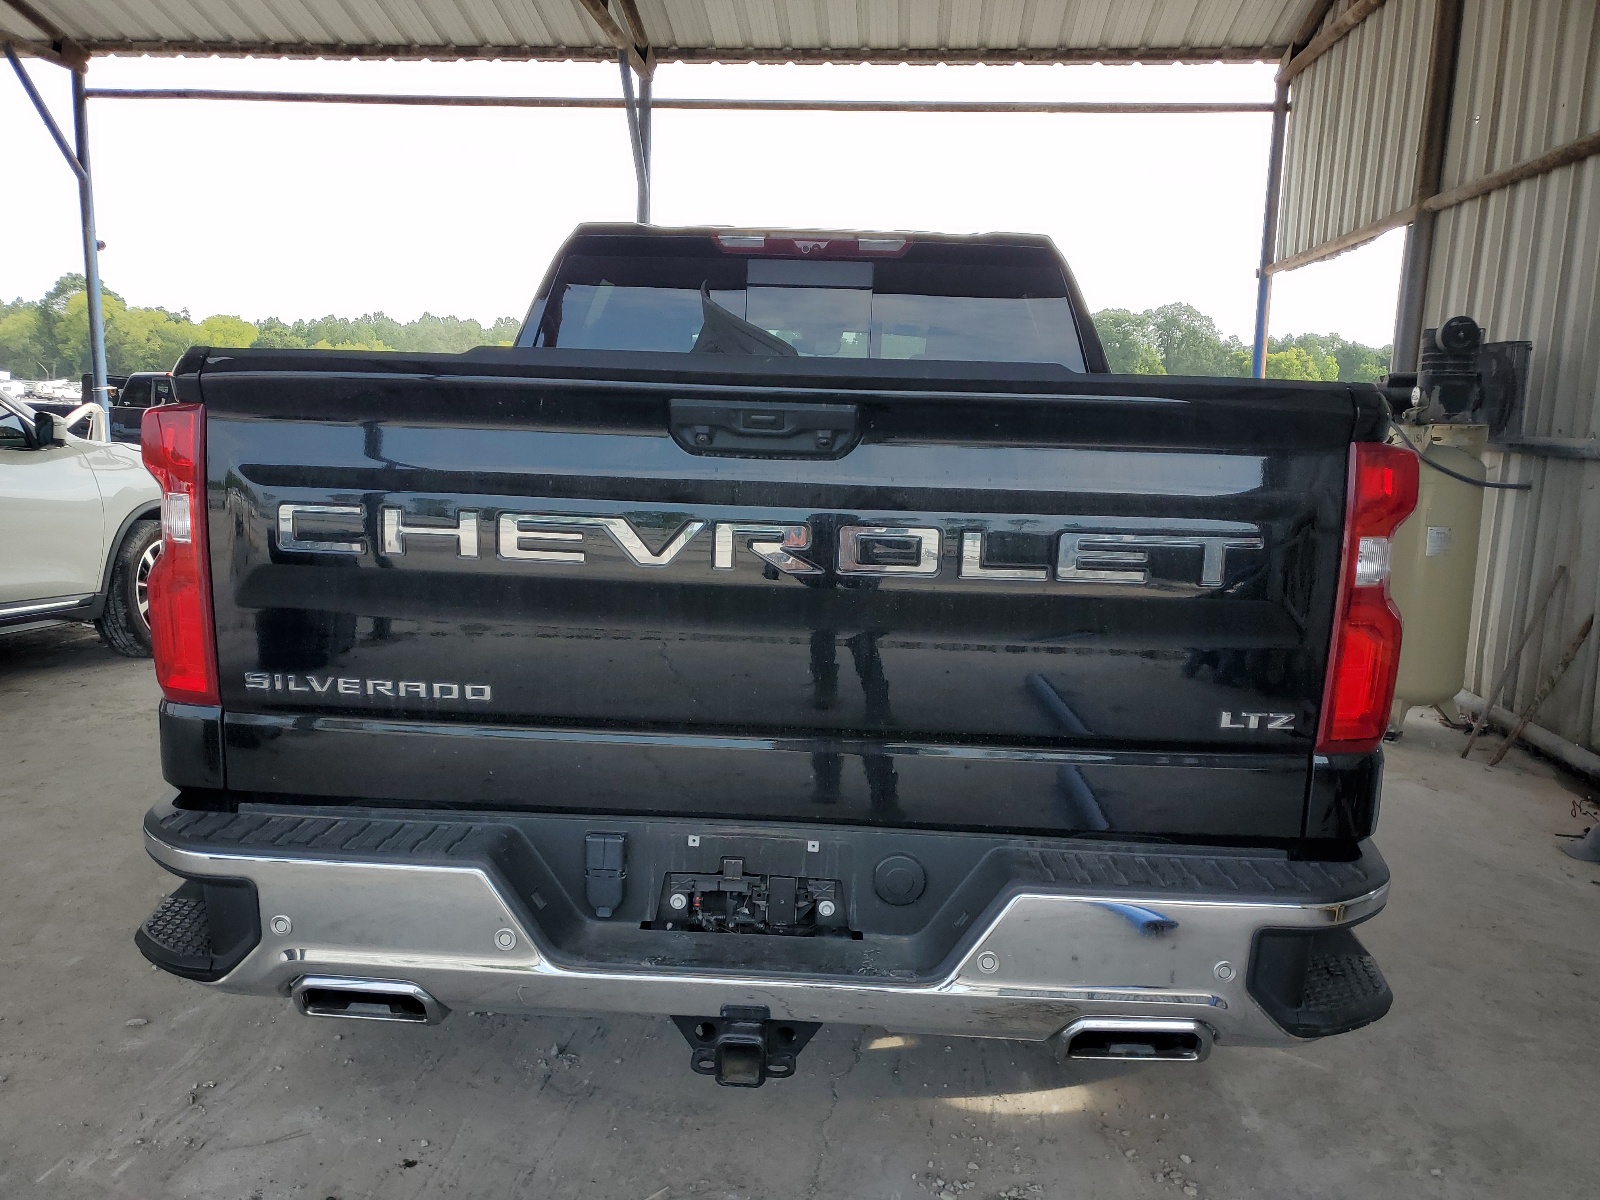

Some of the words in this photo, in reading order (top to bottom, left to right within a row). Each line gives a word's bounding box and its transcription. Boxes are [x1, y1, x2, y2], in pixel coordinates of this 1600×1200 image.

[278, 502, 1264, 587] CHEVROLET
[244, 672, 492, 701] SILVERADO
[1220, 711, 1296, 730] LTZ
